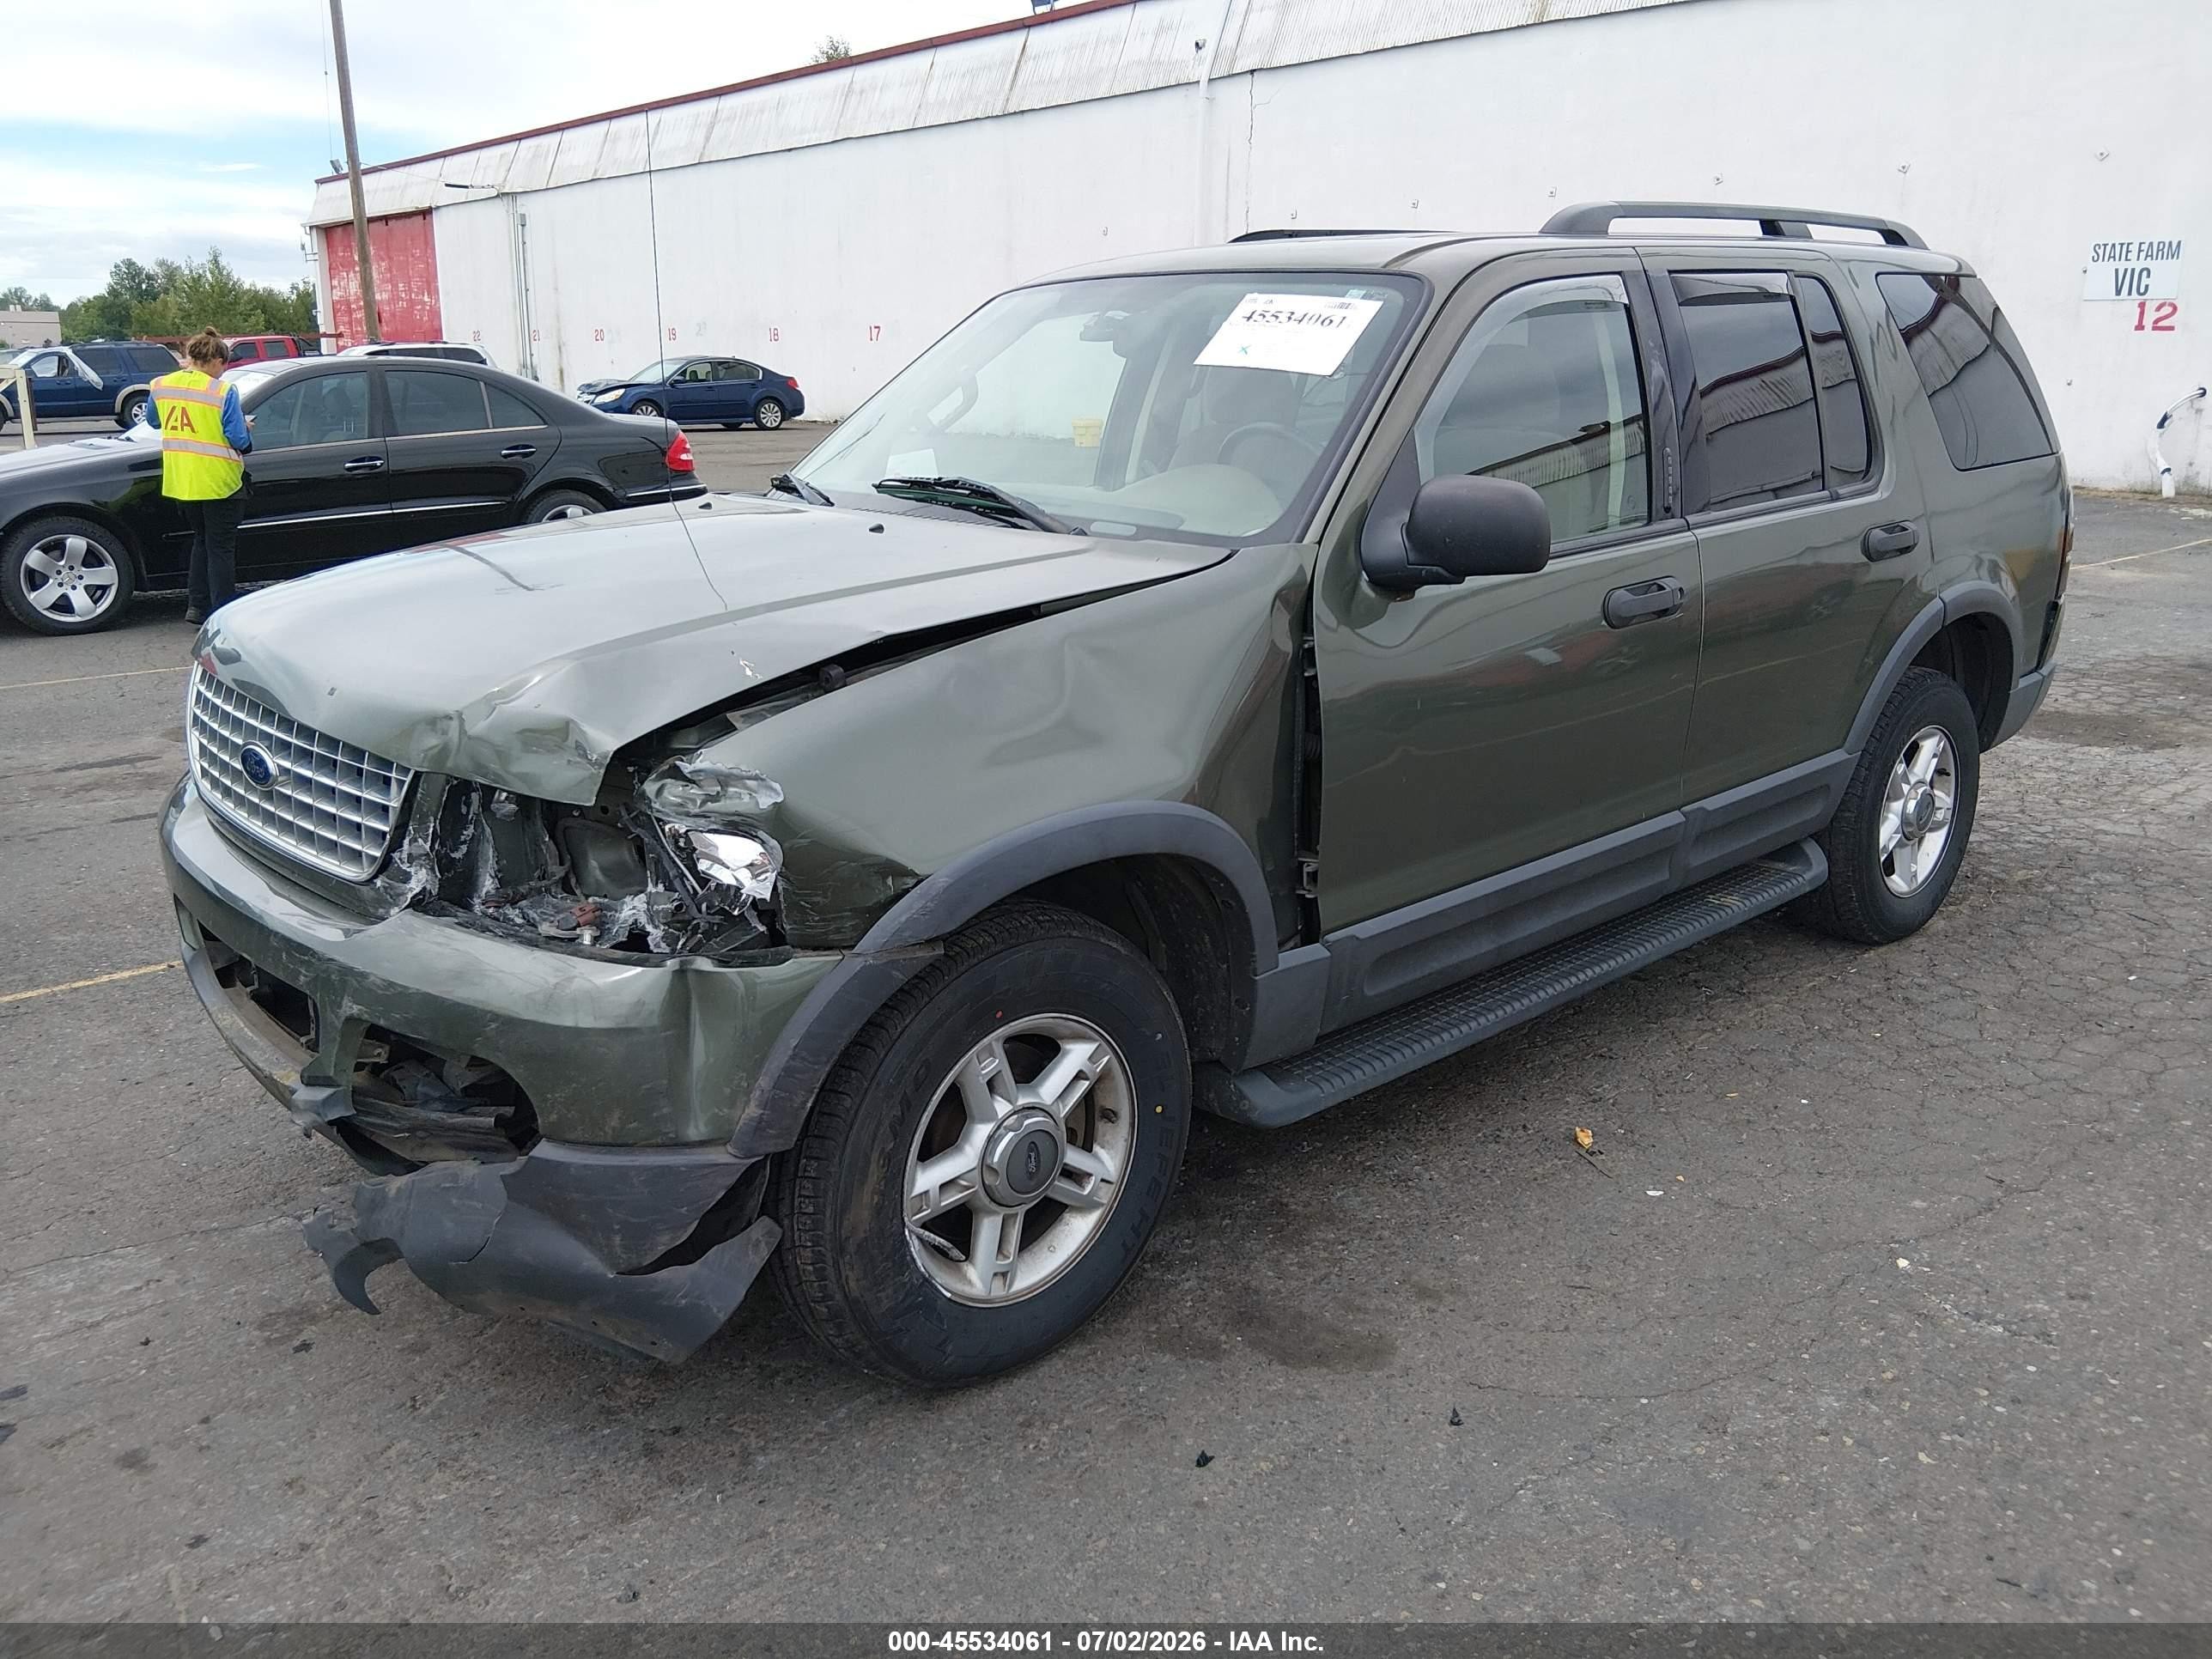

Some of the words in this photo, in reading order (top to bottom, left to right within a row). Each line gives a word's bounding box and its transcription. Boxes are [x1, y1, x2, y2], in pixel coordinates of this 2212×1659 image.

[2091, 242, 2134, 263] STATE
[2136, 240, 2182, 261] FARM
[2114, 267, 2151, 296] VIC
[1243, 309, 1347, 329] 45534061
[2134, 301, 2179, 331] 12
[472, 330, 481, 342] 22
[532, 330, 541, 342] 21
[594, 329, 605, 342] 20
[667, 327, 678, 342] 19
[769, 327, 780, 342] 18
[869, 325, 881, 342] 17
